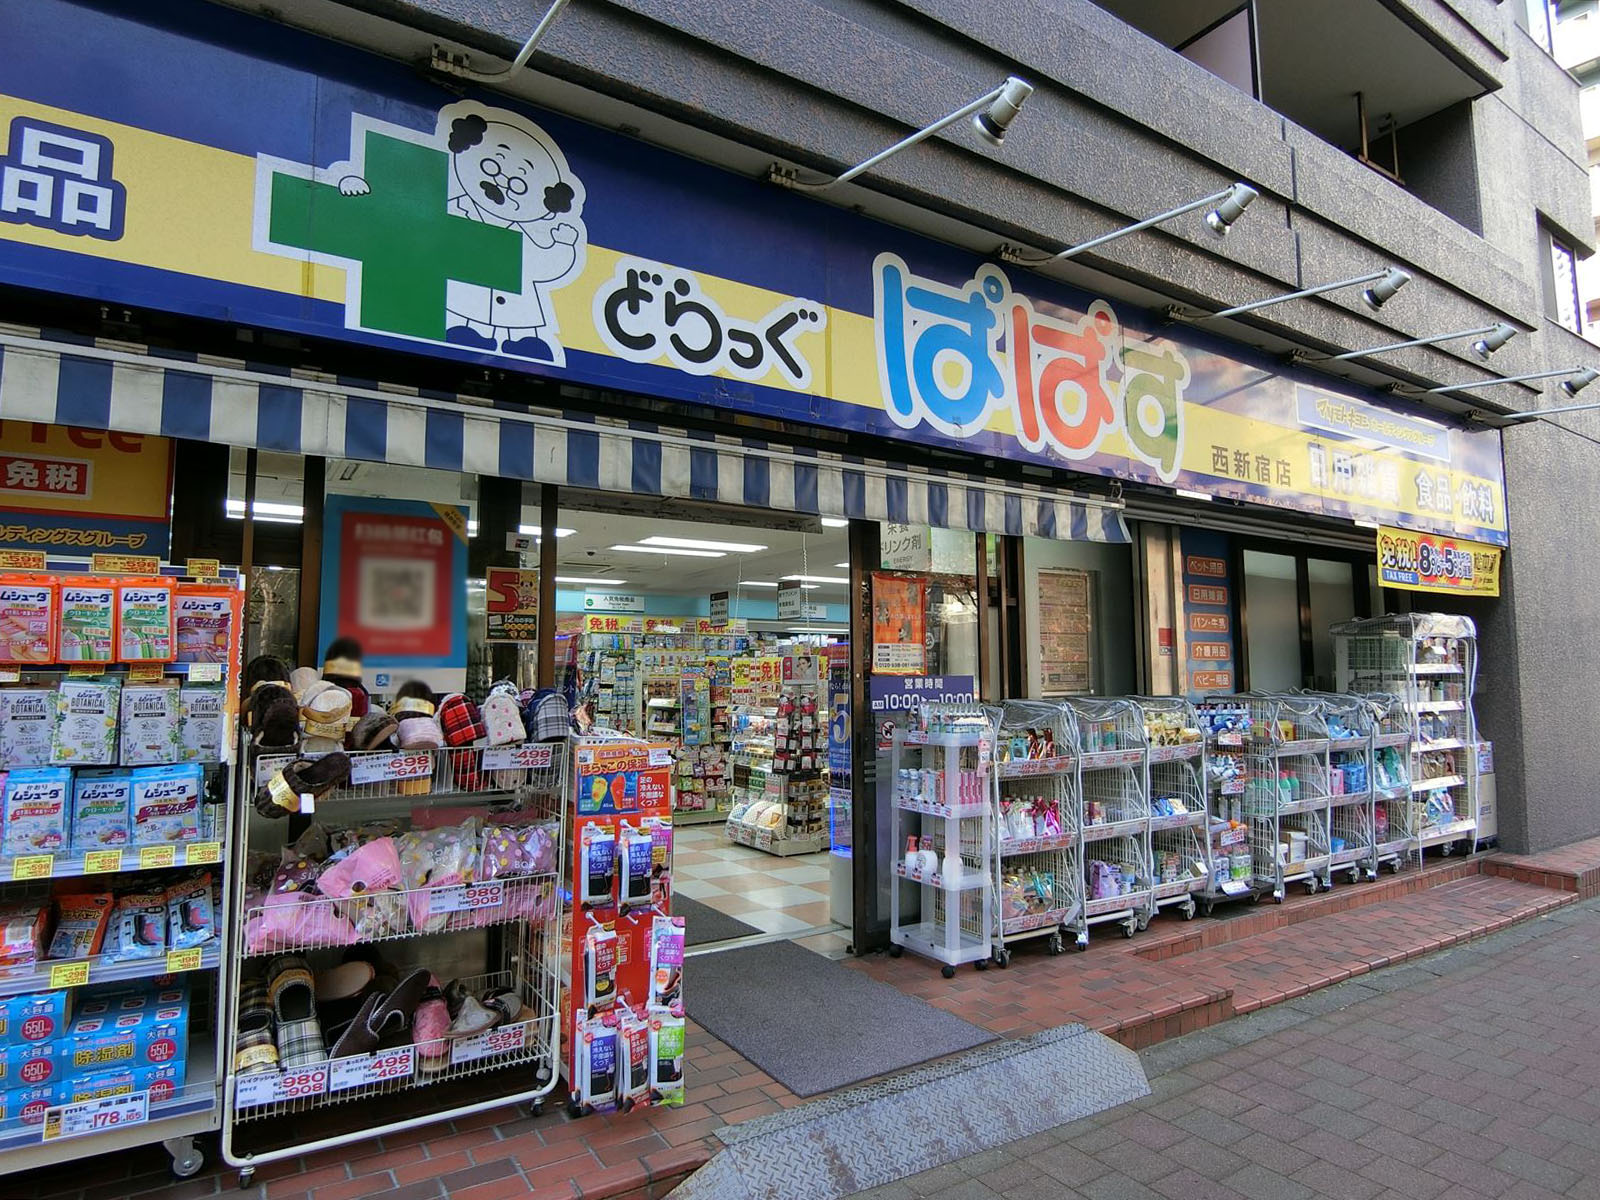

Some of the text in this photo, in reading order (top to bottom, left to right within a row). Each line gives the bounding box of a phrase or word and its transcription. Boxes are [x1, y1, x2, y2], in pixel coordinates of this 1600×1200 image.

[604, 263, 1187, 477] どらっぐ ぱぱす
[1211, 444, 1291, 487] 西新宿店
[6, 460, 79, 492] 免税
[1385, 570, 1413, 583] TAX FREE
[0, 591, 50, 602] ムシューダ
[64, 592, 113, 603] ムシューダ
[123, 592, 169, 602] ムシューダ
[488, 571, 520, 612] 5
[182, 601, 224, 611] ムシューダ
[904, 678, 944, 690] 営業時間
[71, 698, 105, 708] BOTANICAL
[134, 702, 167, 711] BOTANICAL
[190, 703, 221, 712] BOTANICAL
[884, 693, 920, 710] 10:00
[11, 704, 47, 714] BOTANICAL
[516, 749, 551, 759] 498
[391, 755, 429, 769] 698
[397, 765, 429, 776] 647
[12, 788, 63, 801] ムシューダ
[81, 787, 128, 800] ムシューダ
[144, 784, 189, 799] ムシューダ
[466, 886, 501, 898] 980
[471, 896, 499, 906] 908
[488, 1029, 524, 1044] 598
[493, 1039, 522, 1051] 554
[75, 1041, 135, 1067] 除湿剤
[371, 1054, 411, 1070] 498
[377, 1064, 409, 1078] 462
[282, 1071, 326, 1088] 980
[288, 1082, 323, 1097] 908
